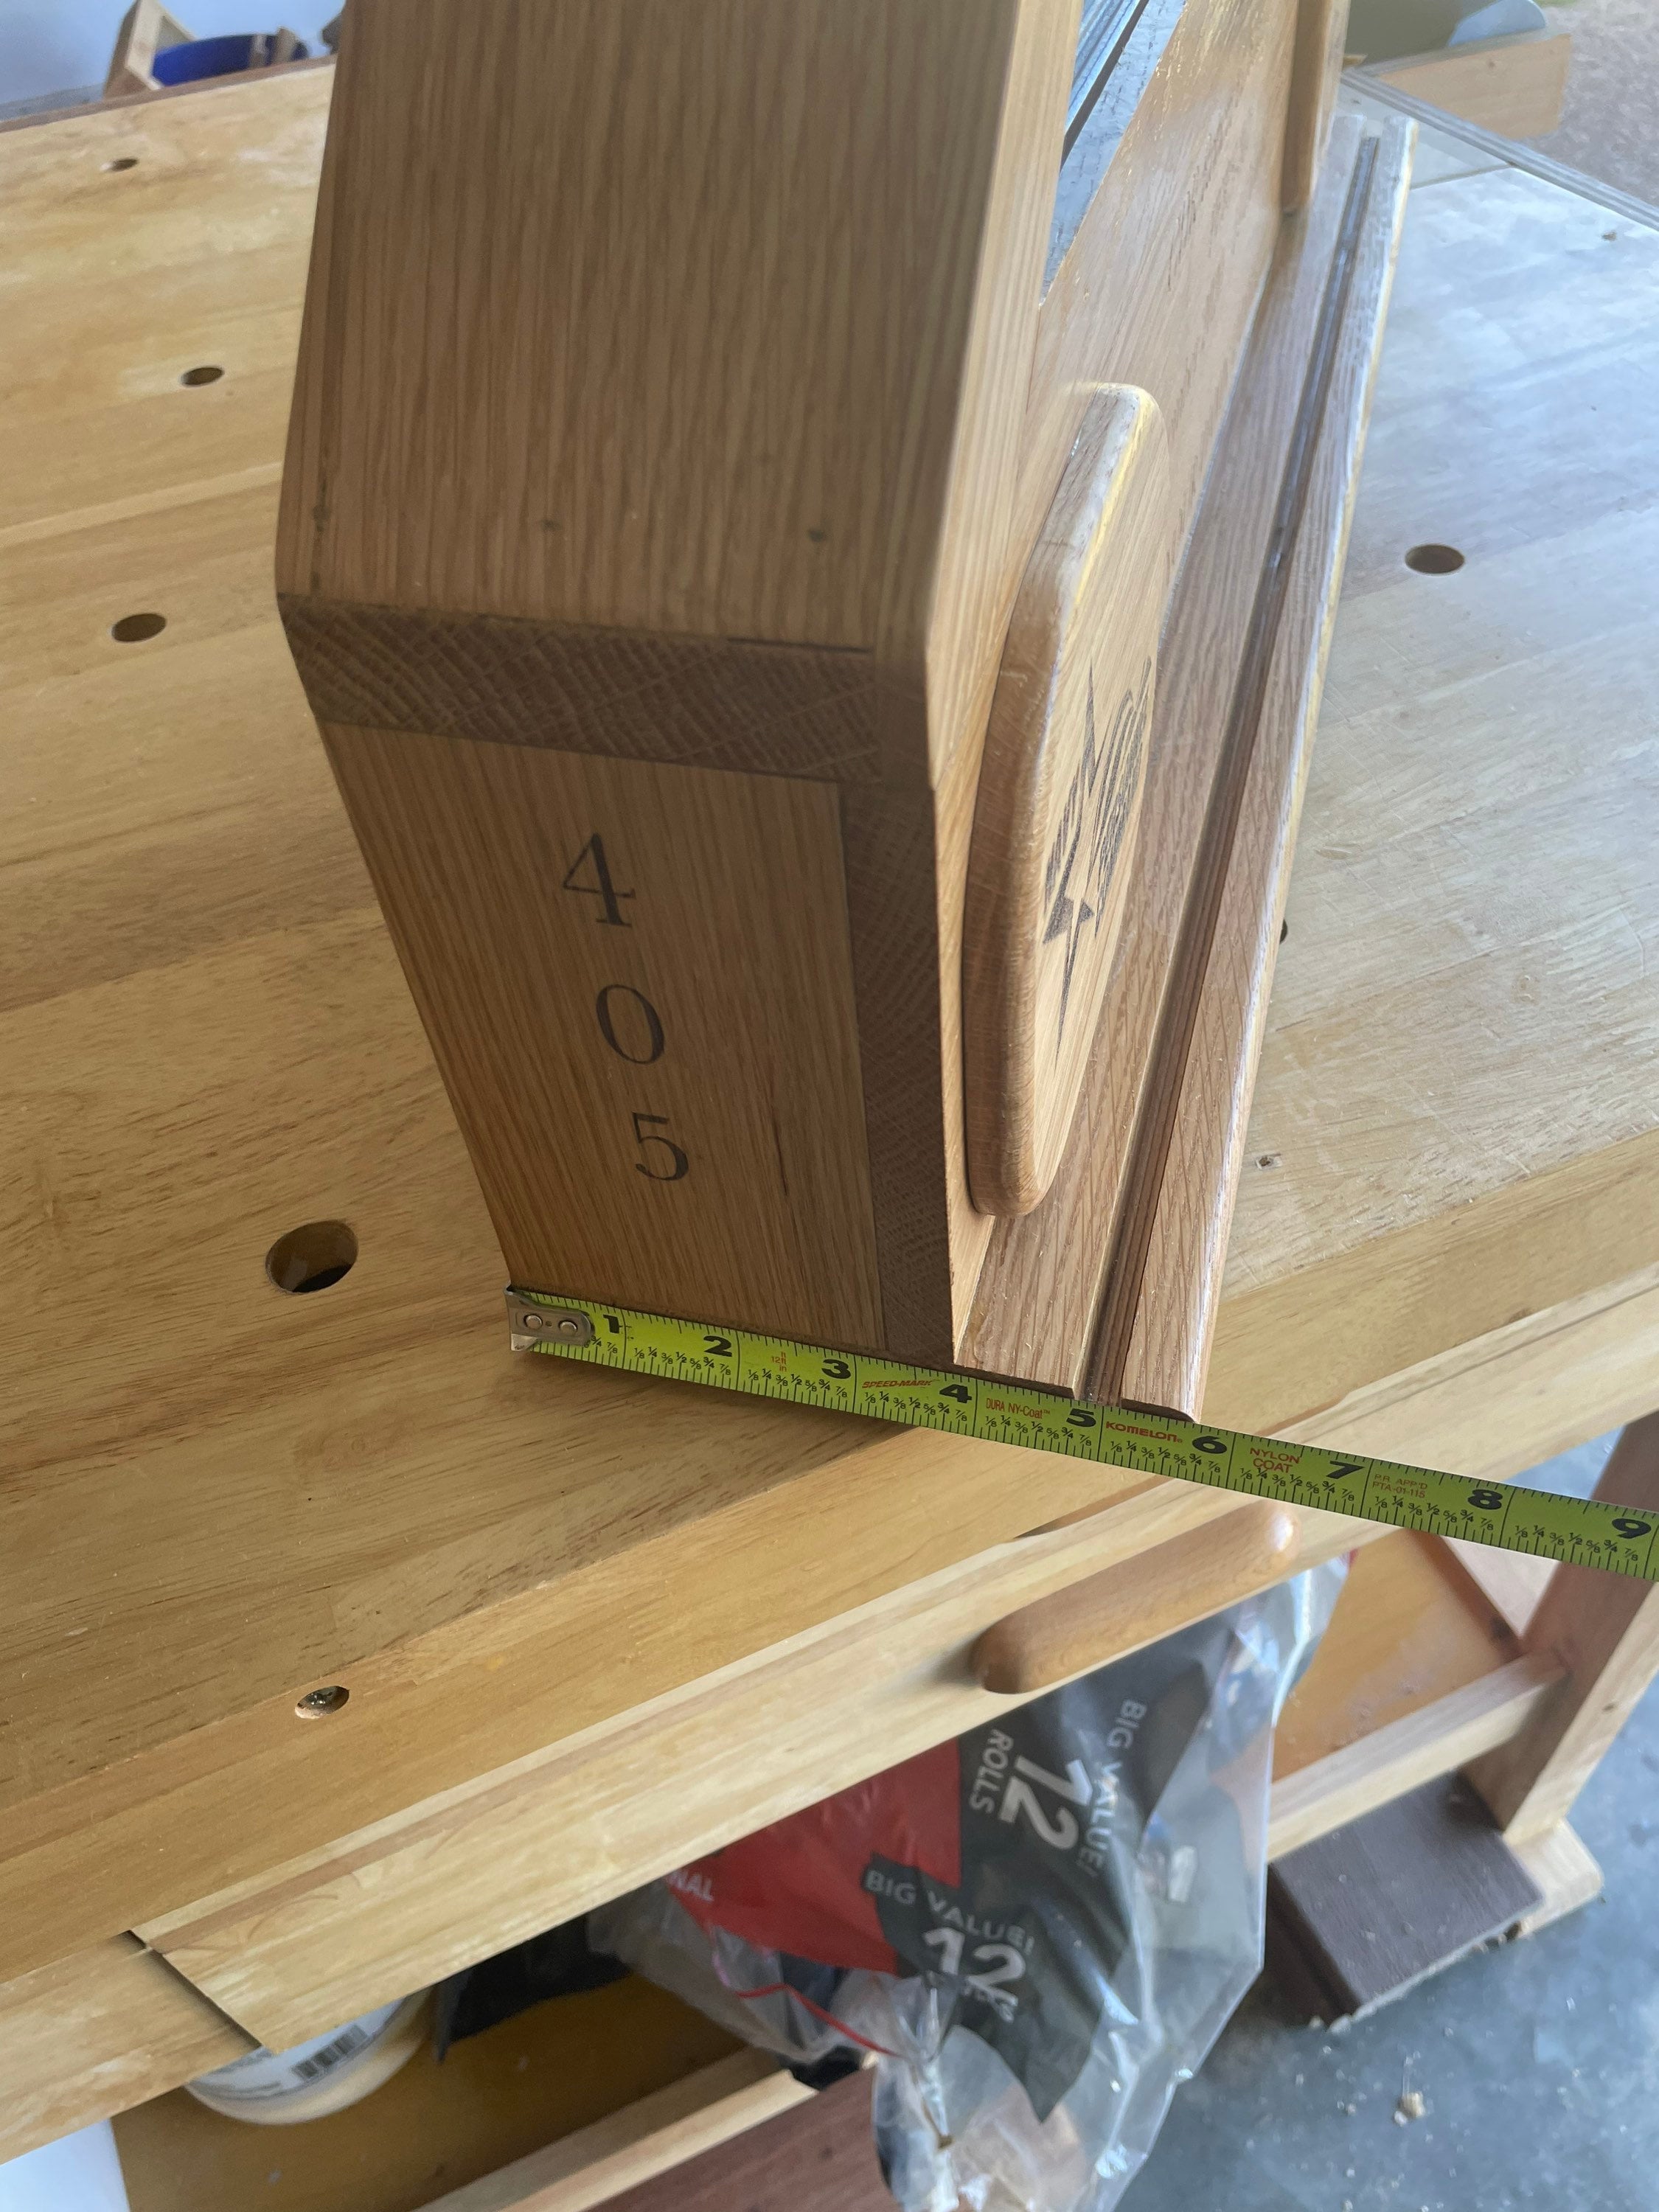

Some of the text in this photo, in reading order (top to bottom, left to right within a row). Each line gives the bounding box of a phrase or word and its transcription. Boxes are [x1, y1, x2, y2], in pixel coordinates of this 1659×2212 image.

[603, 1314, 619, 1334] 1
[591, 1335, 602, 1347] 3/4
[607, 1342, 618, 1353] 7/8
[703, 1335, 732, 1357] 2
[635, 1346, 731, 1375] 1/8 1/4 3/8 1/2 5/8 3/4 7/8
[821, 1359, 851, 1379] 3
[748, 1368, 847, 1397] 1/8 1/4 3/8 1/2 5/8 3/4 7/8
[862, 1380, 932, 1388] SPEED-MARK
[939, 1384, 972, 1403] 4
[866, 1391, 967, 1421] 1/8 1/4 3/8 1/2 5/8 3/4 7/8
[986, 1398, 1004, 1411] DURA
[1066, 1408, 1096, 1427] 5
[985, 1415, 1091, 1446] 1/8 1/4 3/8 1/2 5/8 3/4 7/8
[1110, 1440, 1220, 1472] 1/8 1/4 3/8 1/2 5/8 3/4 7/8
[1192, 1436, 1227, 1454] 6
[1250, 1447, 1300, 1464] NYLON
[1253, 1458, 1293, 1473] COAT
[1326, 1460, 1366, 1479] 7
[1241, 1467, 1354, 1501] 1/8 1/4 3/8 1/2 5/8 3/4 7/8
[1467, 1489, 1503, 1510] 8
[1375, 1495, 1494, 1531] 1/8 1/4 3/8 1/2 5/8 3/4 7/8
[1612, 1518, 1652, 1539] 9
[1515, 1525, 1638, 1561] 1/8 1/4 3/8 1/2 5/8 3/4 7/8
[1107, 1698, 1147, 1750] BIG
[968, 1729, 1015, 1815] ROLLS
[998, 1755, 1093, 1850] 12
[865, 1870, 917, 1906] BIG
[923, 1927, 1026, 2007] 12
